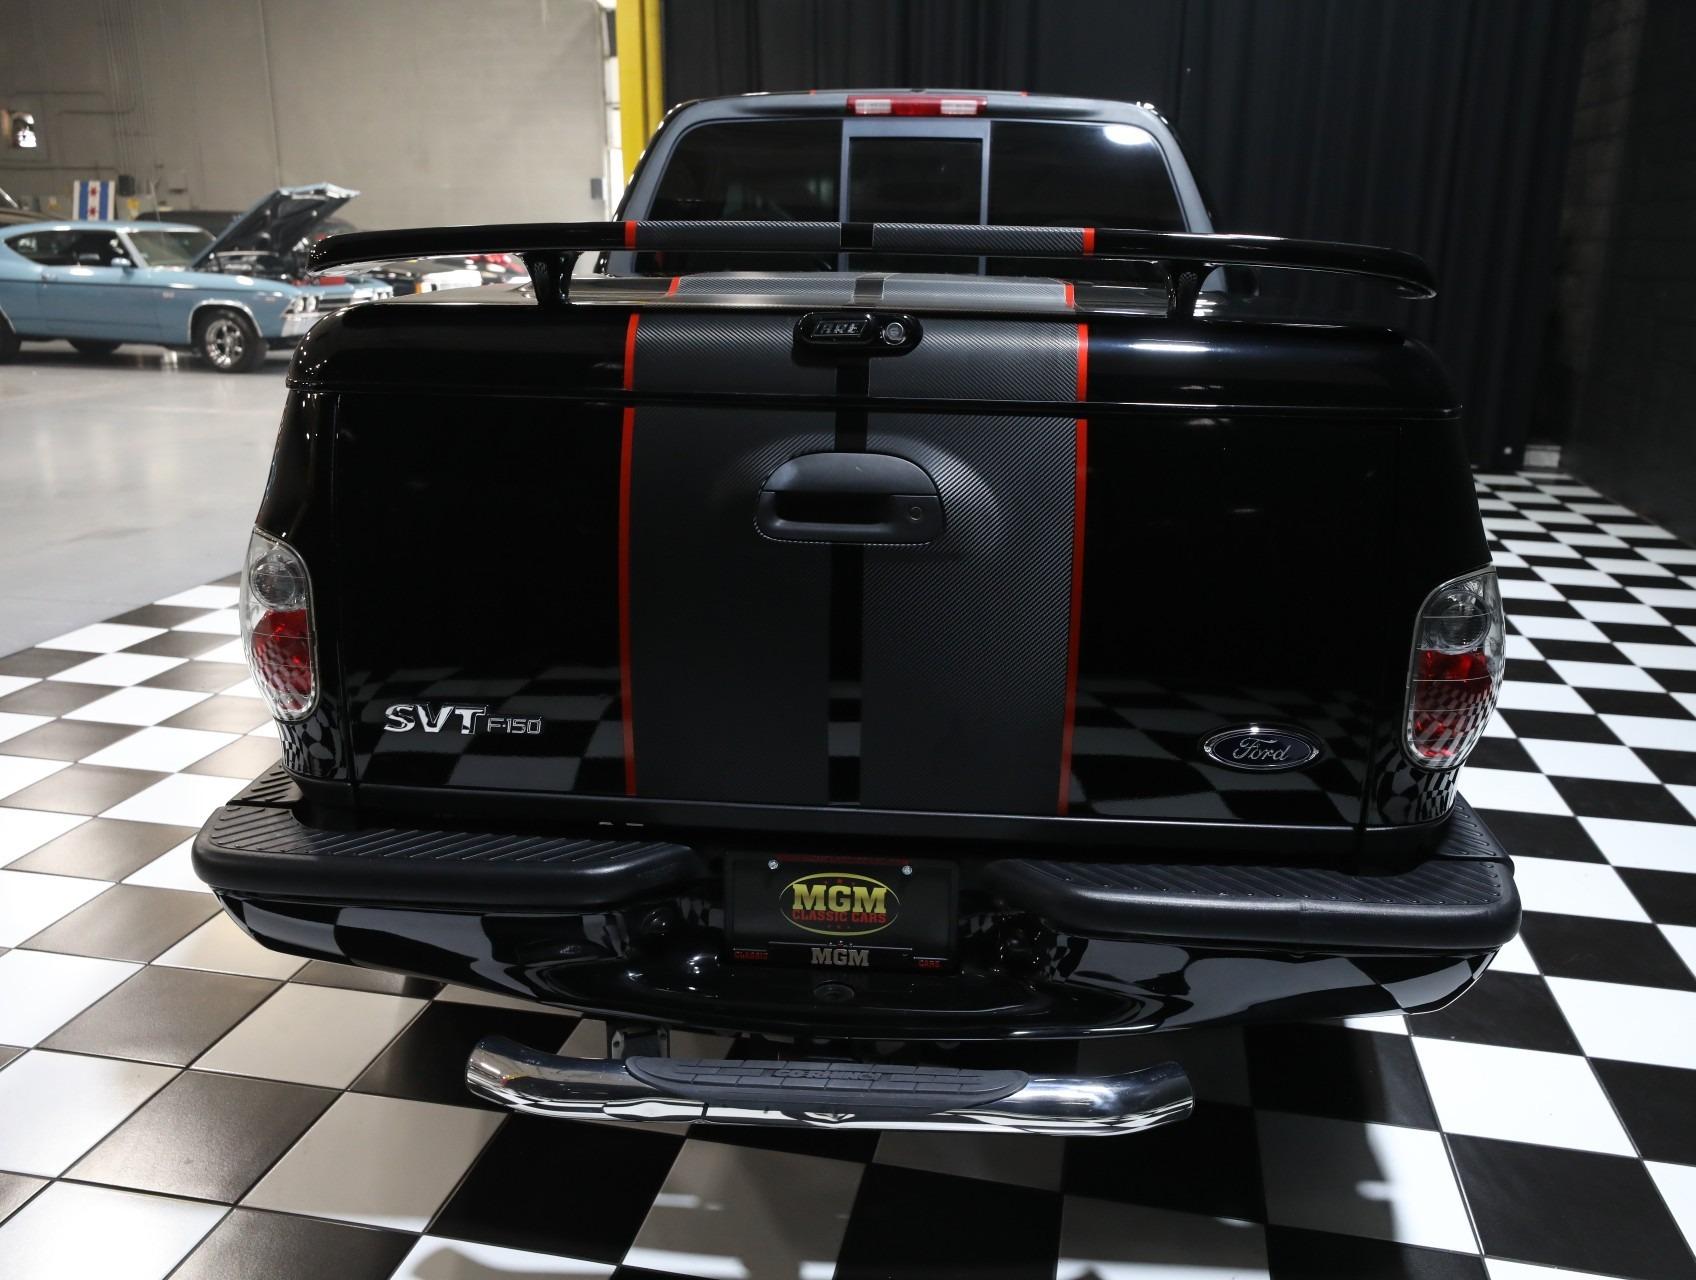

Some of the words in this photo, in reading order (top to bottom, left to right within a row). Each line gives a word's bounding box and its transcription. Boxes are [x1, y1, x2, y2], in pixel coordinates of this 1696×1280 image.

[383, 703, 488, 735] SVT
[487, 716, 543, 735] F-150
[1232, 736, 1292, 761] Ford
[791, 883, 888, 914] MGM
[791, 909, 849, 923] CLASSIC
[851, 911, 888, 925] CARS
[810, 947, 871, 967] MGM
